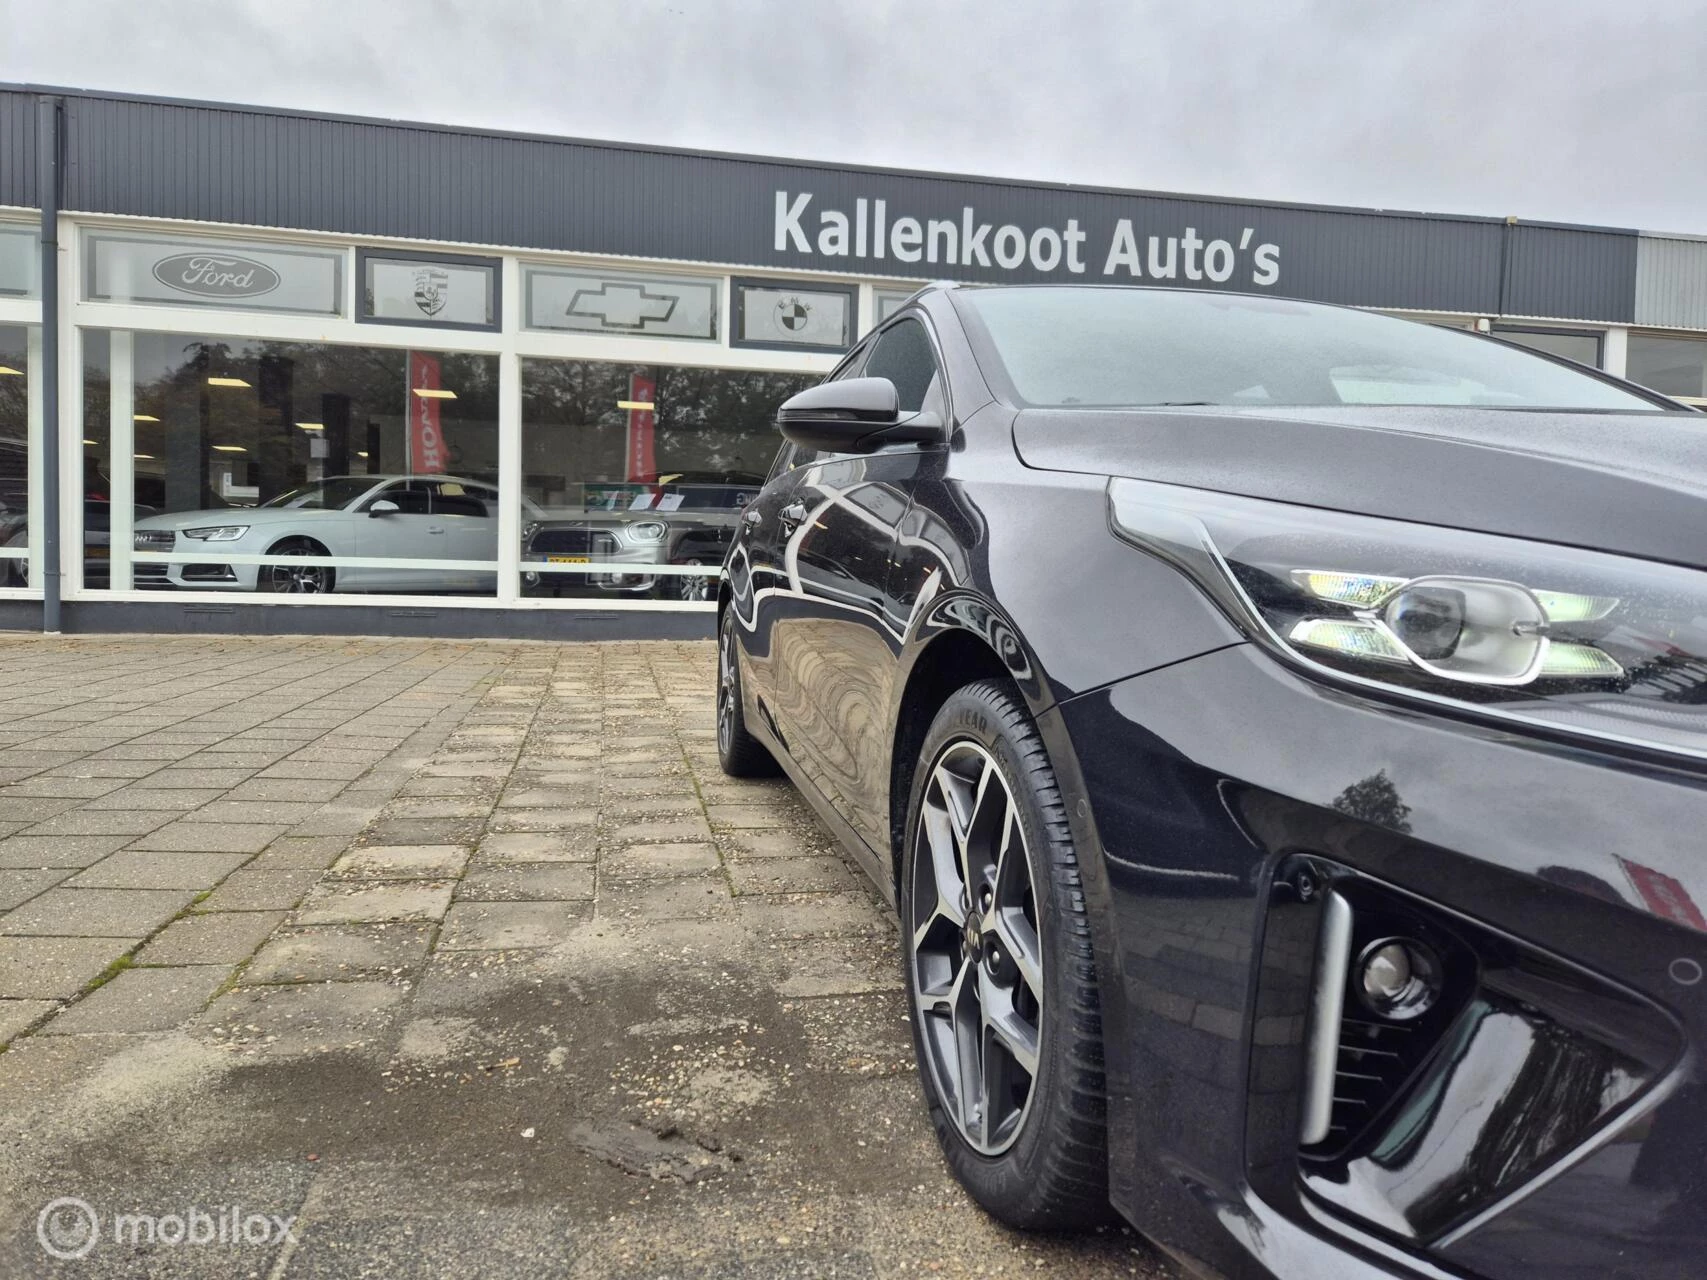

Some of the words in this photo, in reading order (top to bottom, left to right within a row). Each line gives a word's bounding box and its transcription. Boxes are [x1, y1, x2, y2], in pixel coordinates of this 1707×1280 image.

[774, 190, 1086, 274] Kallenkoot
[1103, 219, 1280, 286] Auto's
[181, 256, 255, 289] Ford
